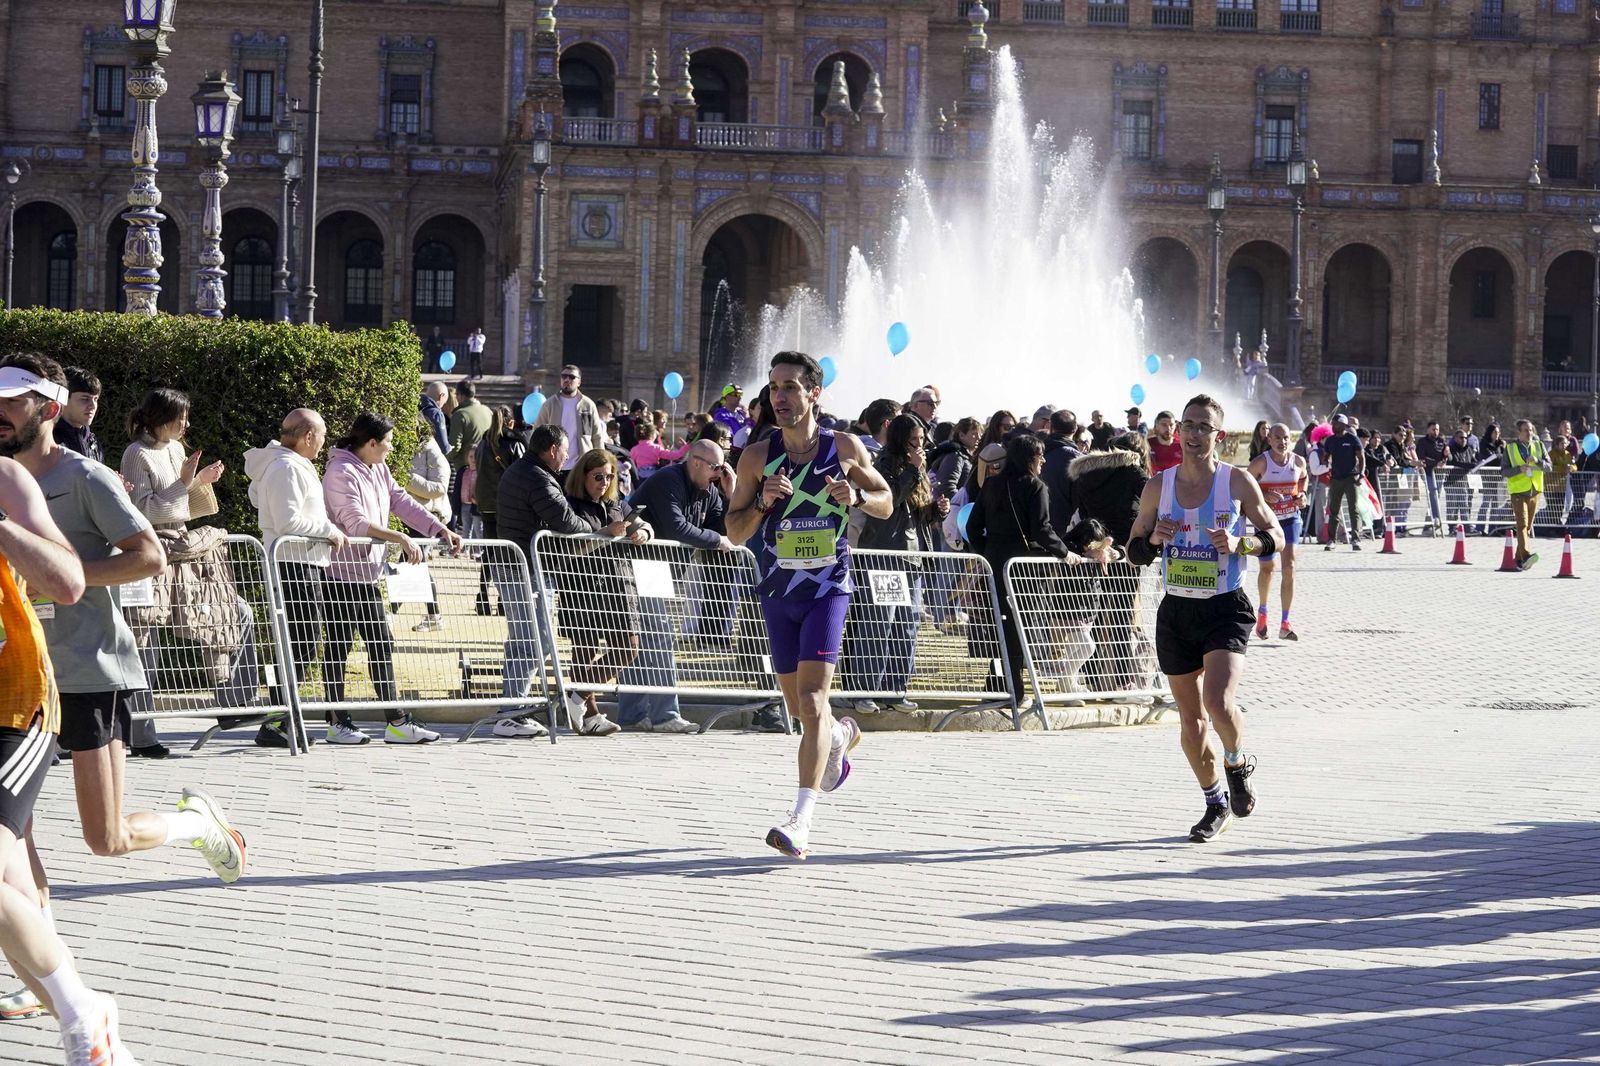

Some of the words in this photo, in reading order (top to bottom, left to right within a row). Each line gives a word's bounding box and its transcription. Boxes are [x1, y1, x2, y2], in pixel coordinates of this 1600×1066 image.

[795, 520, 828, 529] ZURICH
[797, 536, 815, 544] 3125
[795, 546, 819, 557] PITU
[1181, 550, 1212, 559] ZURICH
[1182, 565, 1197, 573] 2254
[1168, 574, 1216, 587] JJRUNNER
